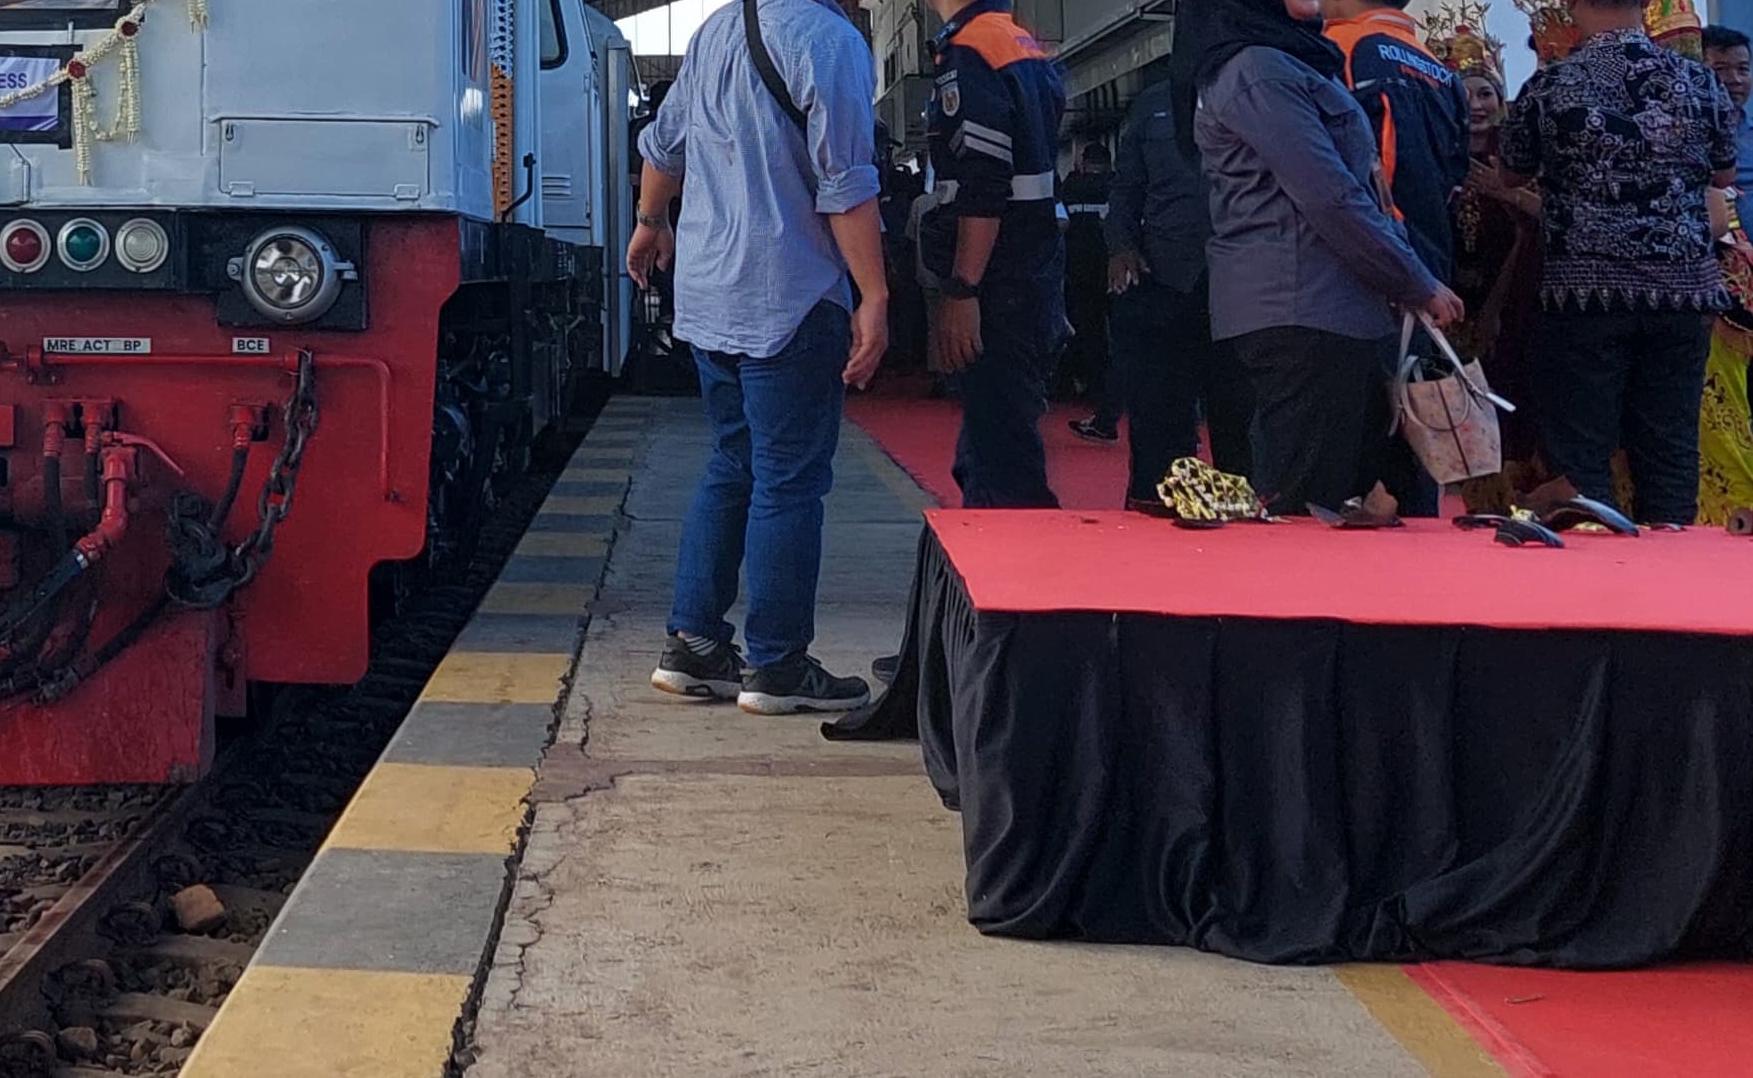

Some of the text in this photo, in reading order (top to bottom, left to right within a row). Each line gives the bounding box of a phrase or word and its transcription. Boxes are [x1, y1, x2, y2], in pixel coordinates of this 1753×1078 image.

[47, 339, 142, 350] MRE ACT BP
[237, 339, 264, 350] BCE
